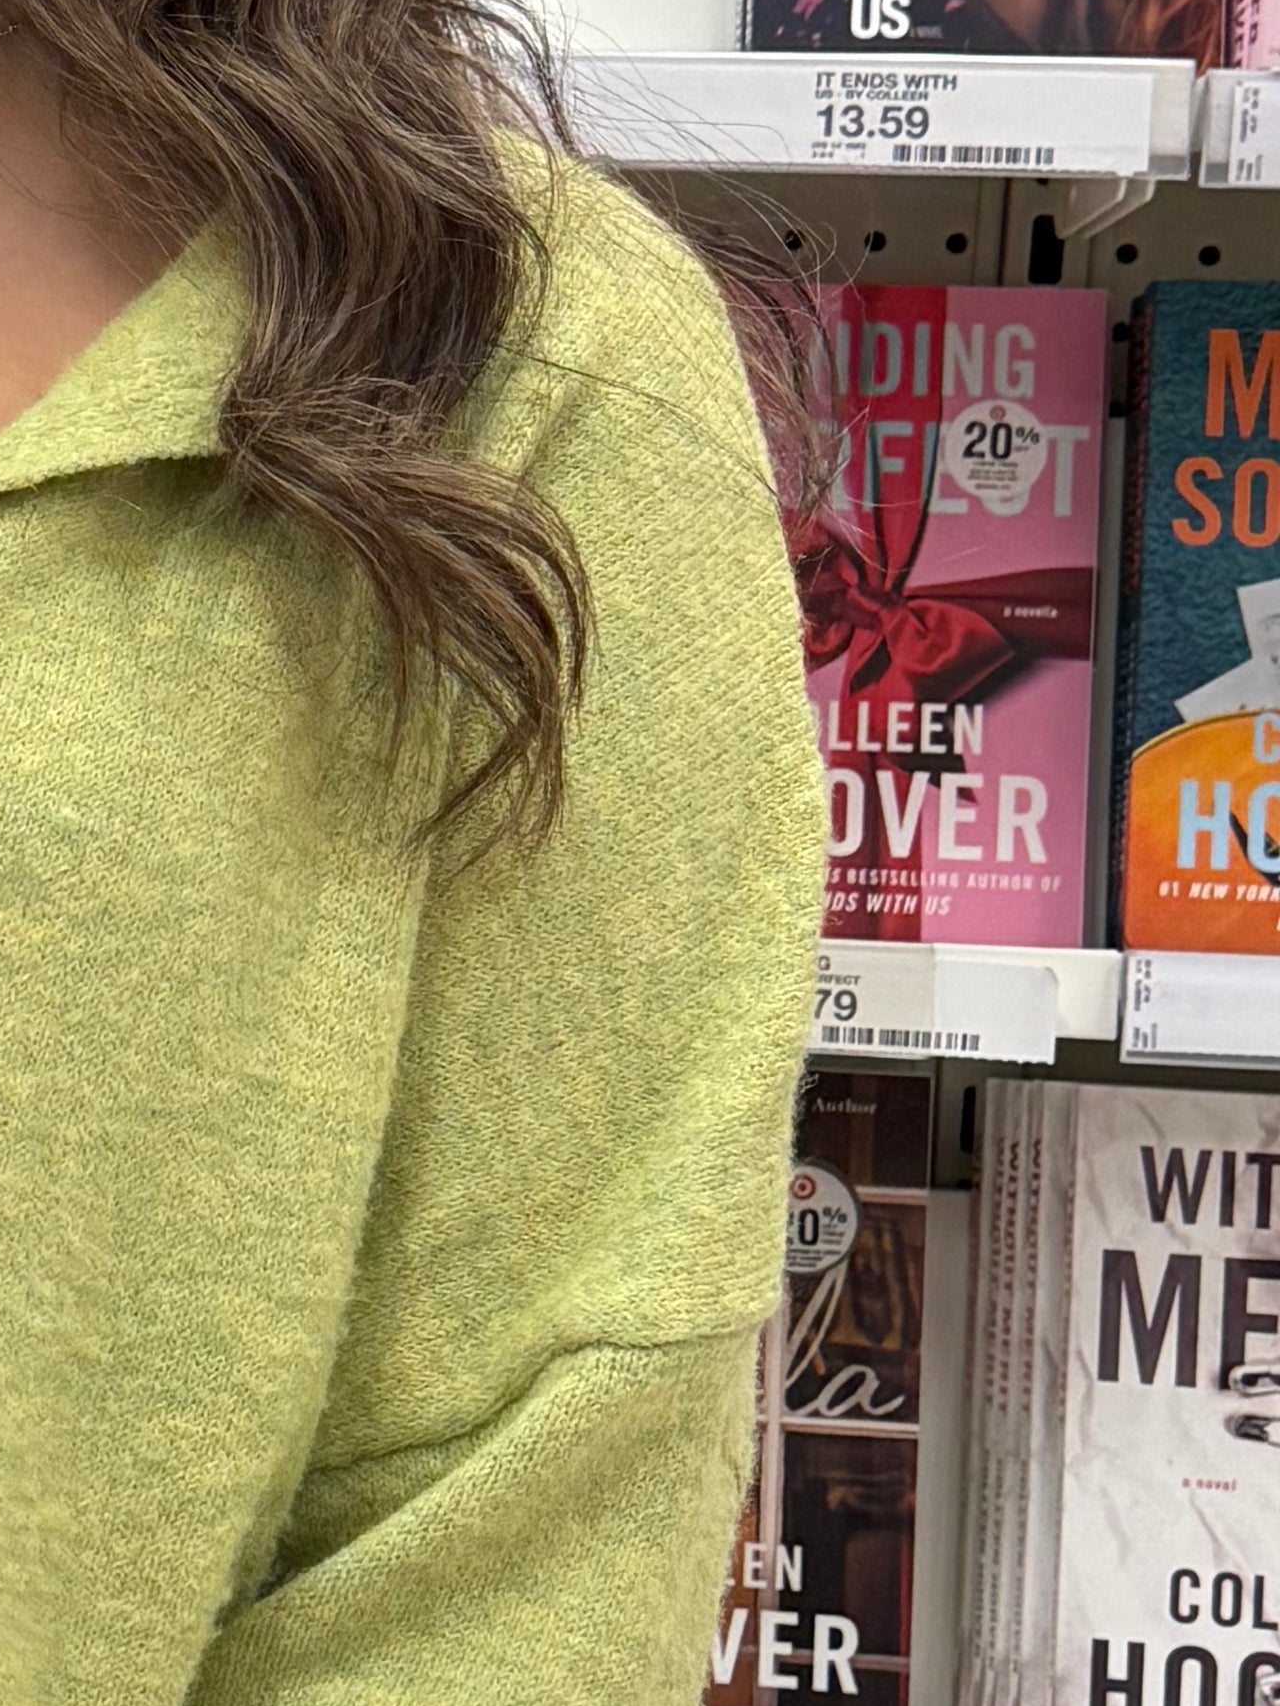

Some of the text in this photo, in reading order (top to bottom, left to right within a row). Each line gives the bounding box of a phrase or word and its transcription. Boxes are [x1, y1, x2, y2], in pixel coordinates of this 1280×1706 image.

[816, 72, 957, 91] IT ENDS WITH
[817, 105, 929, 139] 13.59
[847, 869, 1061, 891] BESTSELLING AUTHOR OF
[866, 895, 950, 915] WITH US
